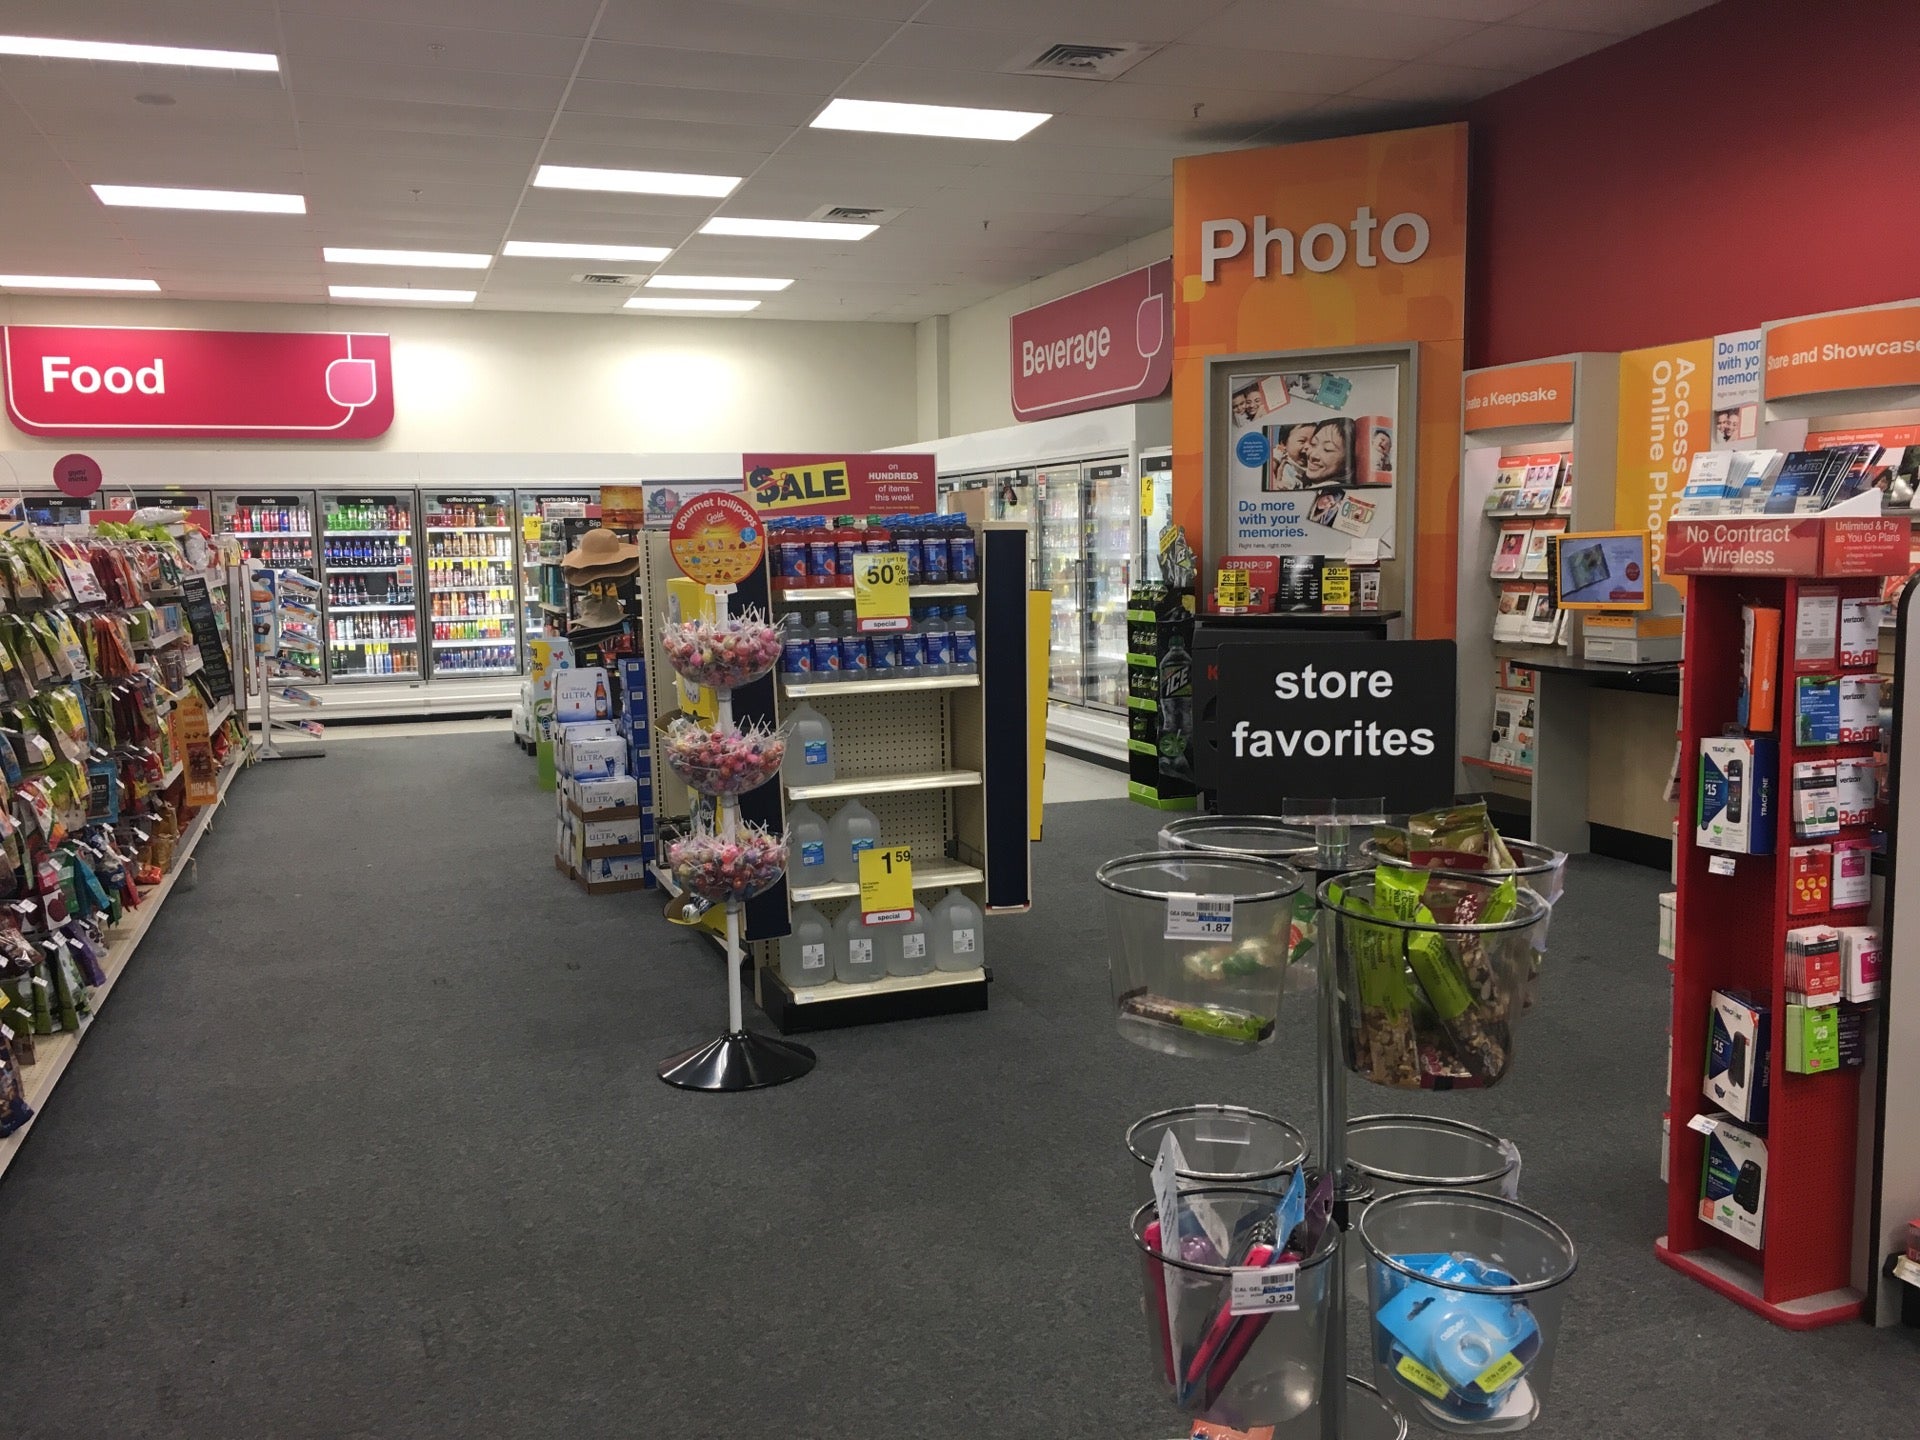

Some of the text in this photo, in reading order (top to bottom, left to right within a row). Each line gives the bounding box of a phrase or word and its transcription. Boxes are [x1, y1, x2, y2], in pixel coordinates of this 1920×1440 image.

[1201, 206, 1430, 282] Photo
[1022, 325, 1111, 378] Beverage
[1718, 338, 1761, 356] Do mor
[1717, 355, 1760, 371] with yo
[1767, 354, 1789, 371] Share
[1791, 347, 1818, 365] and
[41, 356, 165, 395] Food
[1717, 370, 1761, 386] memori
[1482, 396, 1489, 407] a
[1490, 387, 1557, 407] Keepsake
[1649, 360, 1672, 462] Online
[1671, 356, 1696, 475] Access
[868, 472, 919, 480] HUNDREDS
[1238, 500, 1295, 512] Do more
[676, 496, 758, 531] gourmet lollipops
[706, 509, 725, 522] Gold
[1238, 513, 1300, 527] with your
[1238, 525, 1308, 538] memories.
[1687, 524, 1790, 543] No Contract
[1835, 520, 1899, 533] Unlimited & Pay
[1834, 531, 1901, 543] as You Go Plans
[1702, 547, 1774, 565] Wireless
[1226, 561, 1273, 569] SPINPOP
[1165, 665, 1189, 696] ICE
[1273, 662, 1394, 700] store
[562, 691, 592, 699] ULTRA
[1231, 719, 1436, 758] favorites
[576, 753, 604, 762] ULTRA
[1705, 783, 1717, 796] $15
[586, 795, 614, 804] ULTRA
[589, 832, 617, 841] ULTRA
[877, 912, 900, 921] special
[1202, 923, 1230, 932] $1.87
[1813, 1026, 1828, 1040] $25
[1265, 1293, 1293, 1304] $3.29
